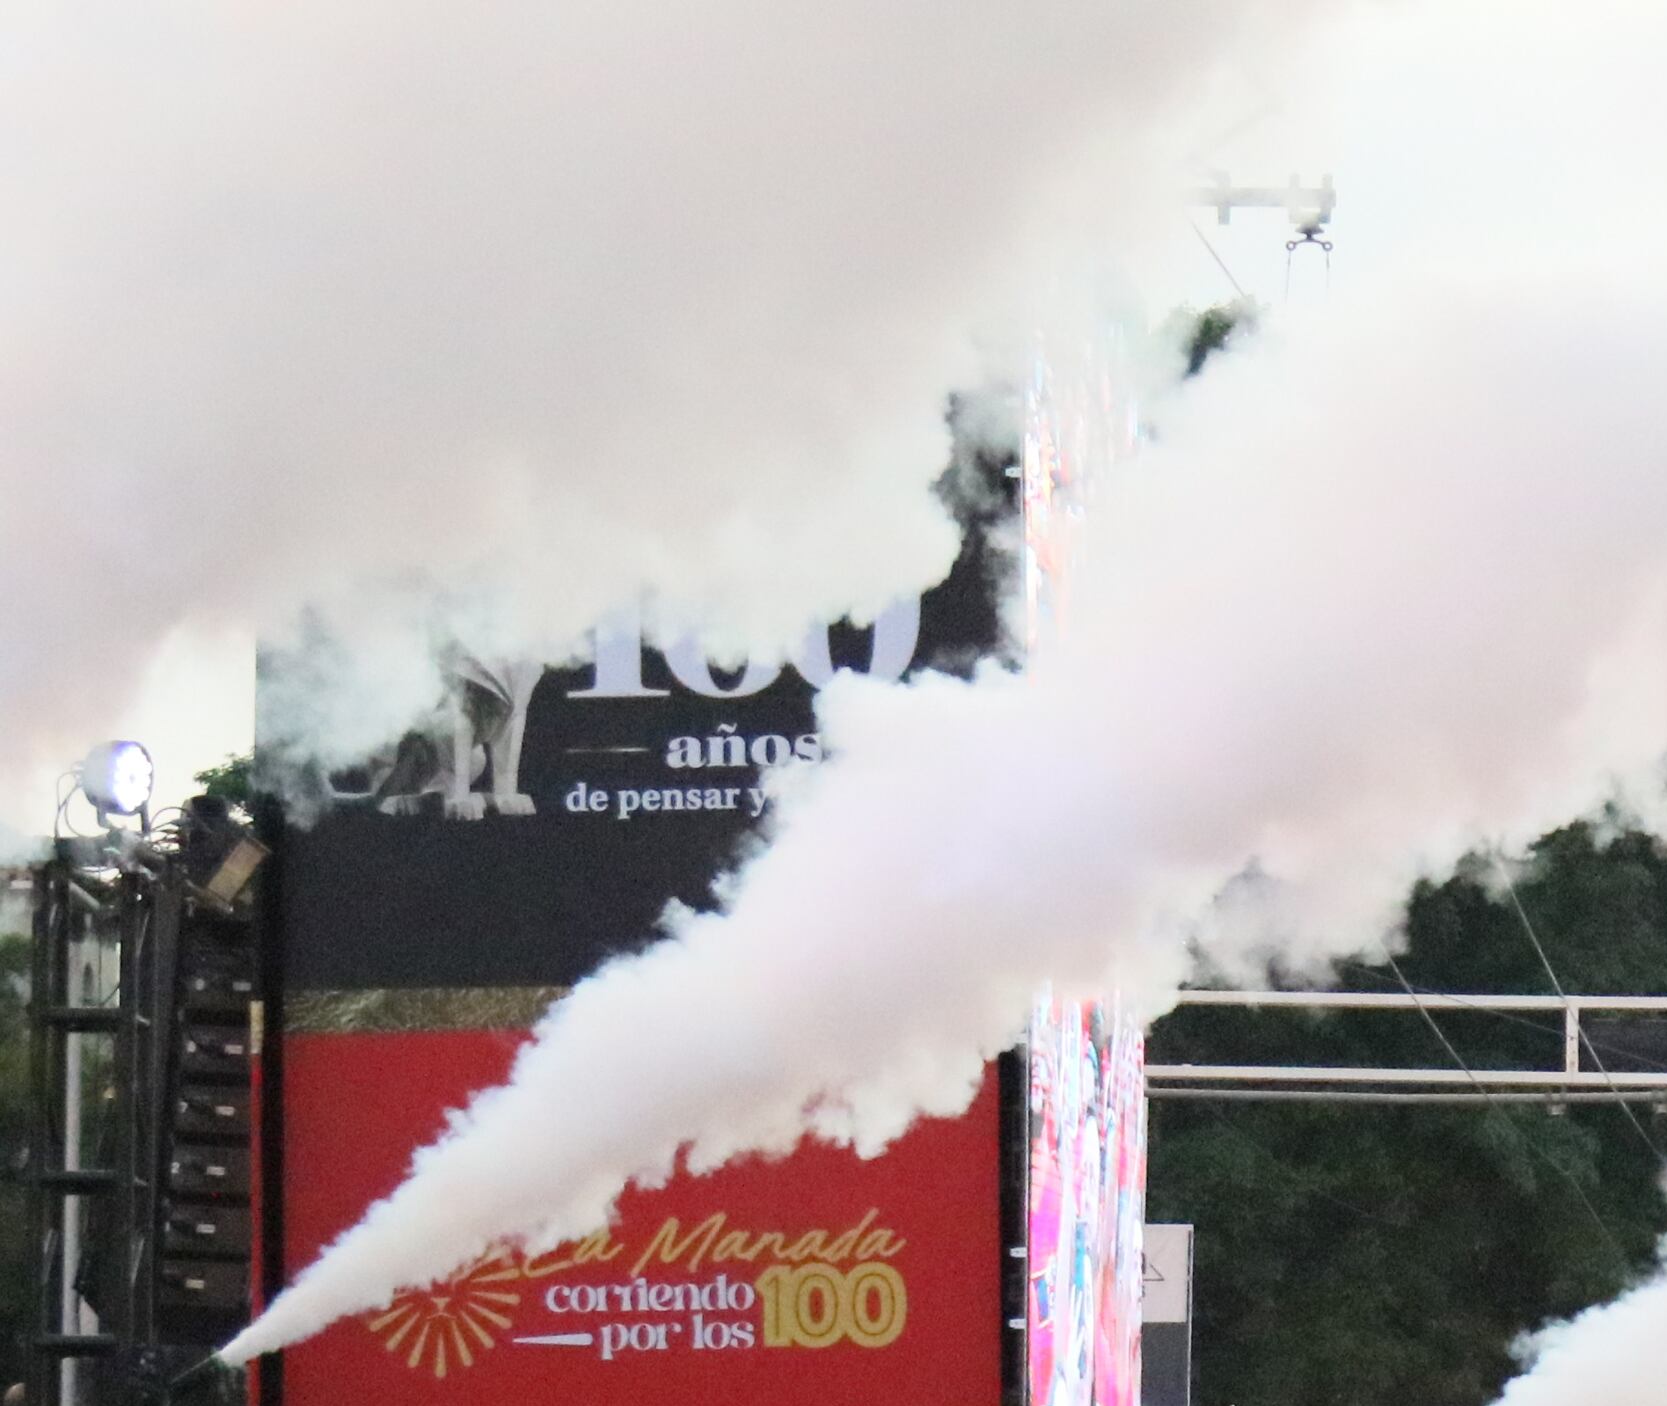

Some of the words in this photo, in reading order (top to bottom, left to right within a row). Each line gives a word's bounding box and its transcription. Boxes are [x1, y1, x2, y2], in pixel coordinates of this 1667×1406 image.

[665, 722, 825, 769] años
[566, 783, 609, 812] de
[617, 787, 741, 820] pensar
[630, 1206, 907, 1277] Manada
[545, 1274, 757, 1314] corriendo
[754, 1262, 908, 1348] 100
[600, 1322, 681, 1361] por
[692, 1318, 757, 1351] los
